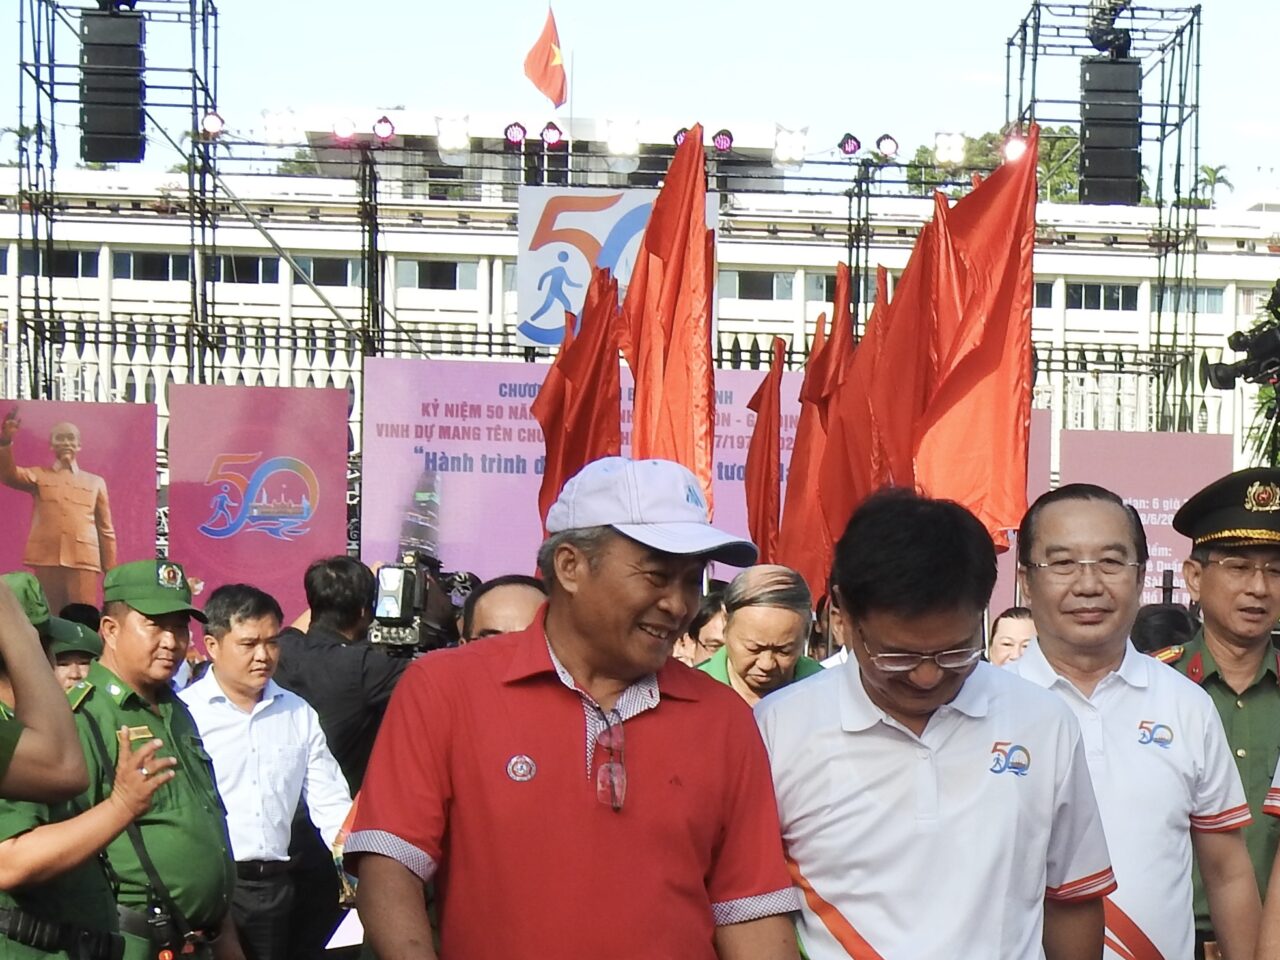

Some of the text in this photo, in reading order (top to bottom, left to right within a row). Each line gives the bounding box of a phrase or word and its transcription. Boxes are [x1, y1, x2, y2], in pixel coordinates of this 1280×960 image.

[498, 383, 542, 398] CHƯƠ
[421, 398, 440, 418] KỶ
[444, 401, 482, 421] NIỆM
[486, 405, 504, 419] 50
[508, 403, 536, 420] NĂ
[376, 423, 410, 438] VINH
[414, 423, 436, 442] DỰ
[438, 425, 481, 441] MANG
[486, 424, 513, 441] TÊN
[481, 453, 527, 474] trình
[197, 452, 319, 539] 50
[1152, 498, 1160, 509] 6
